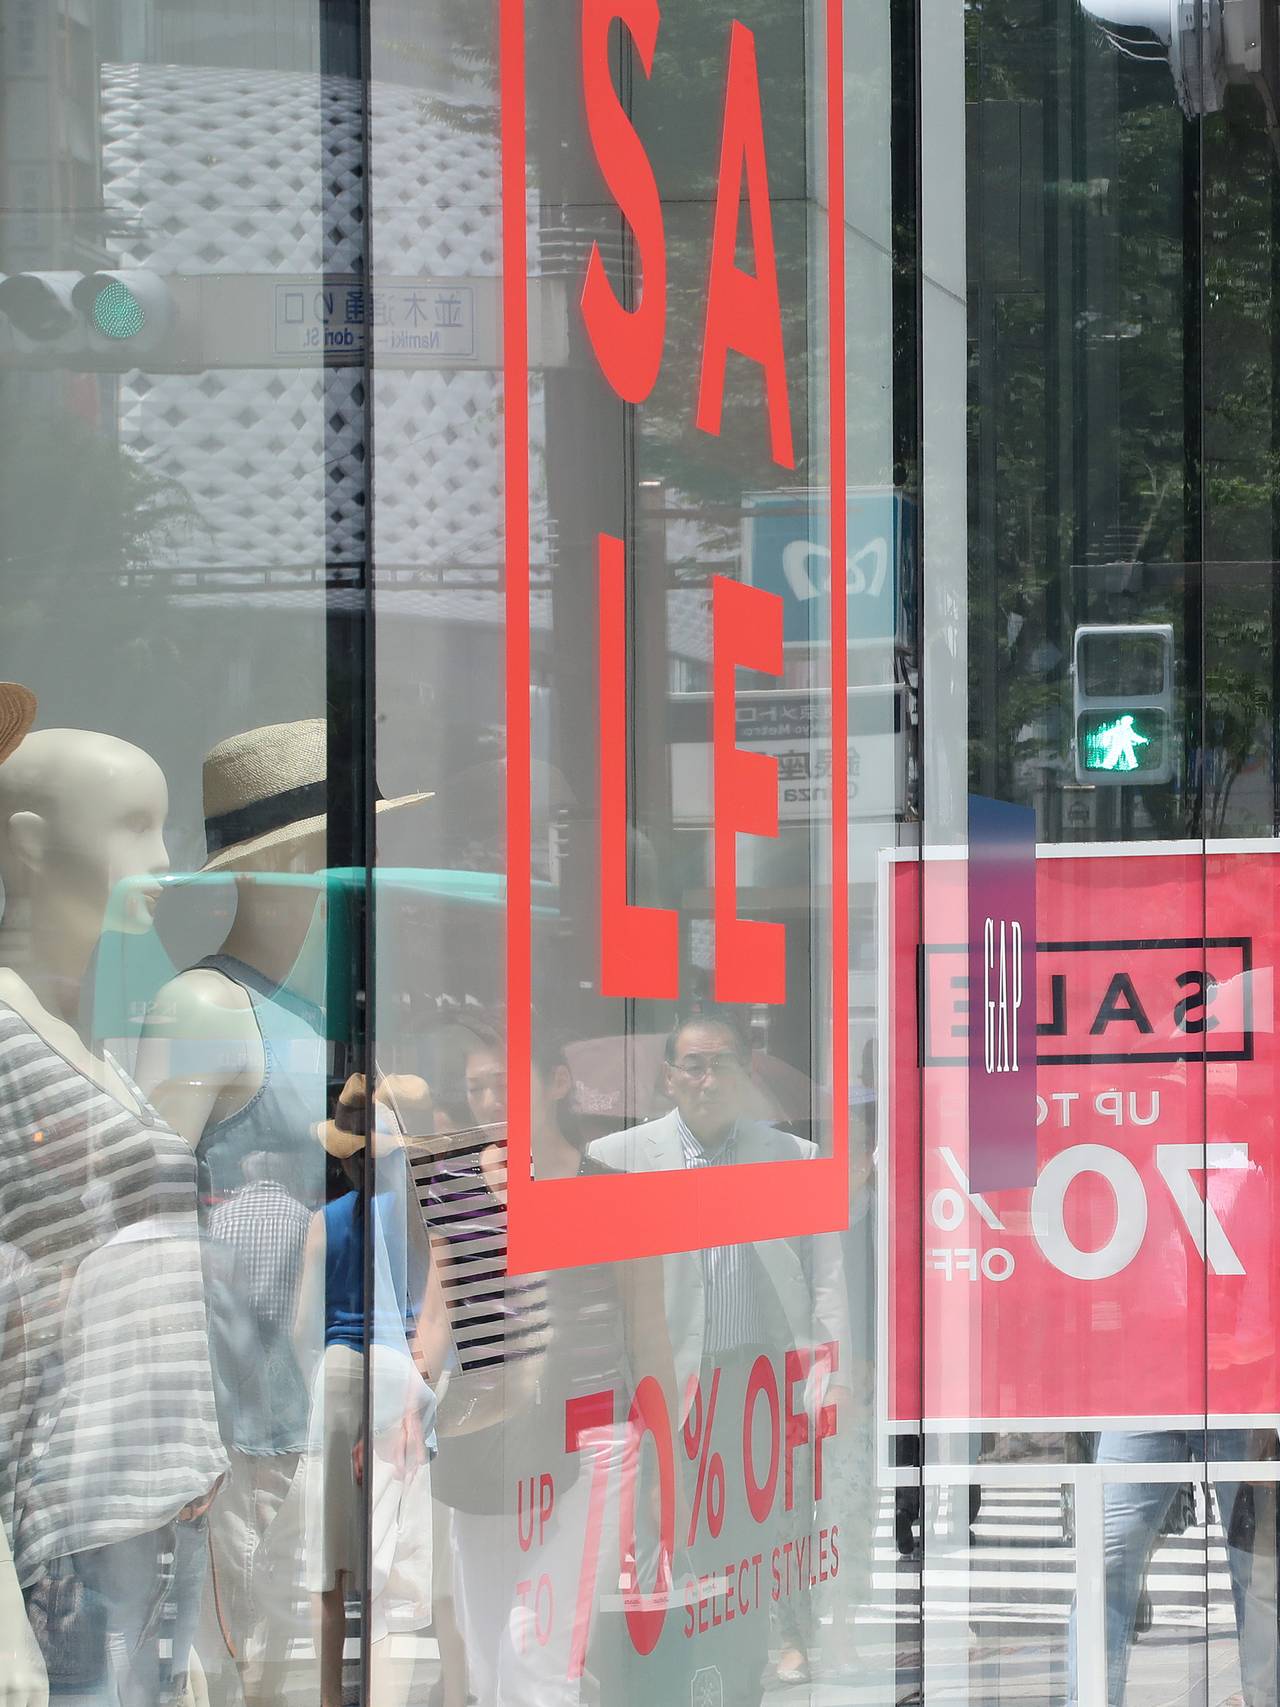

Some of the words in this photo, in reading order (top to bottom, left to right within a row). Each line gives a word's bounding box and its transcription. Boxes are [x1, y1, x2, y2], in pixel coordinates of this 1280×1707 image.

[984, 917, 1023, 1073] GAP
[517, 1472, 555, 1552] UP
[565, 1366, 726, 1682] 70%
[743, 1340, 840, 1524] OFF
[516, 1573, 555, 1656] TO
[684, 1553, 762, 1639] SELECT
[771, 1525, 840, 1602] STYLES
